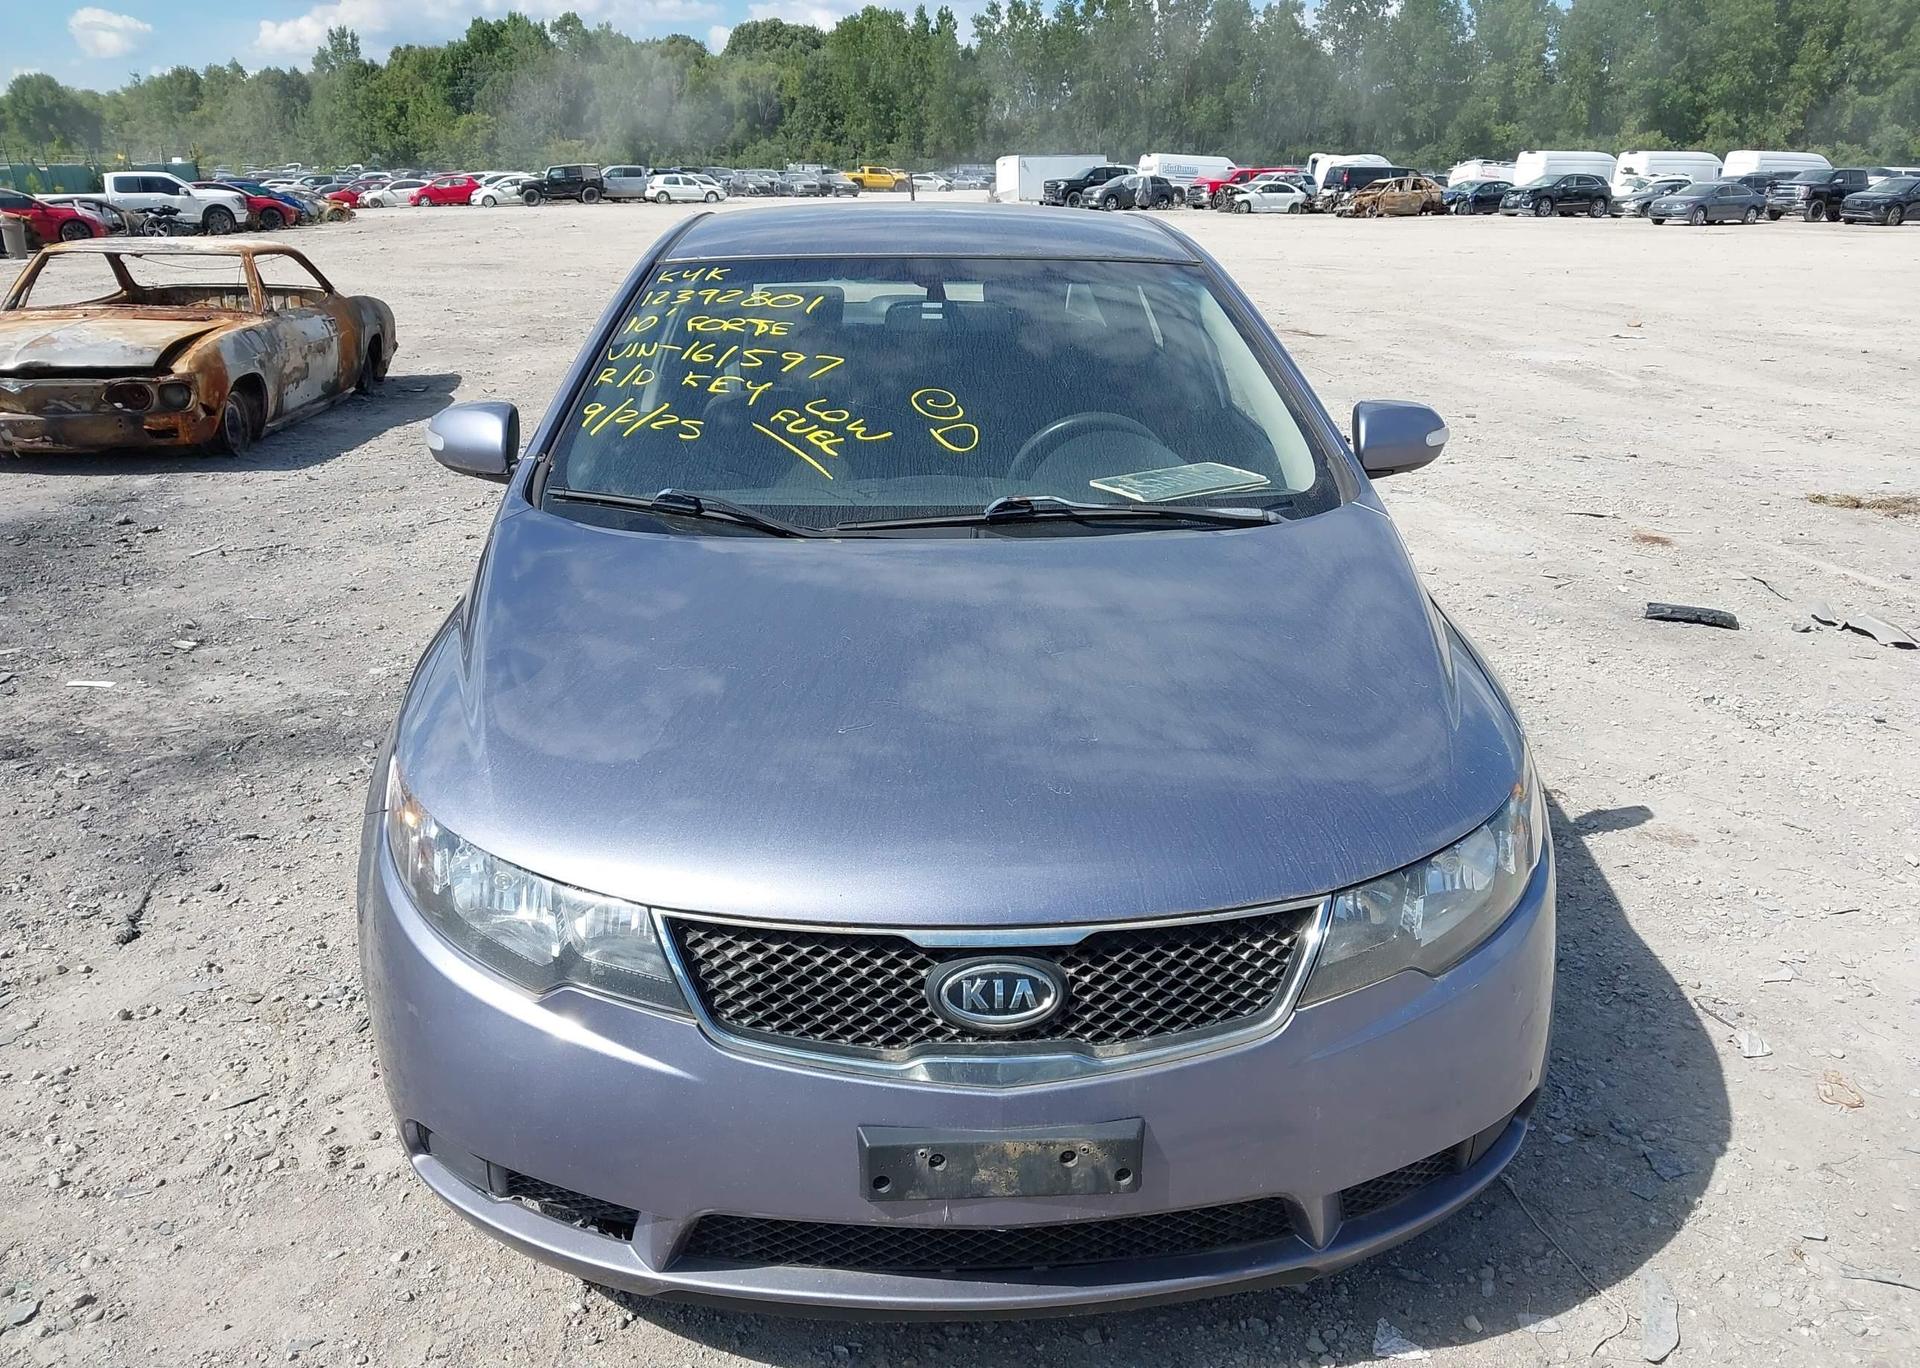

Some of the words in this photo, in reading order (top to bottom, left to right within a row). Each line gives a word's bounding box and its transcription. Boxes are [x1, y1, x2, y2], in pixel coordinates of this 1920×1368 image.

[641, 289, 825, 314] 12392801
[687, 316, 795, 336] FORTE
[593, 364, 655, 388] R/D
[682, 371, 774, 406] KEY
[582, 398, 704, 439] 9/2/25
[770, 409, 844, 456] FUEL
[805, 399, 893, 441] LOW
[961, 978, 1038, 1010] KIA
